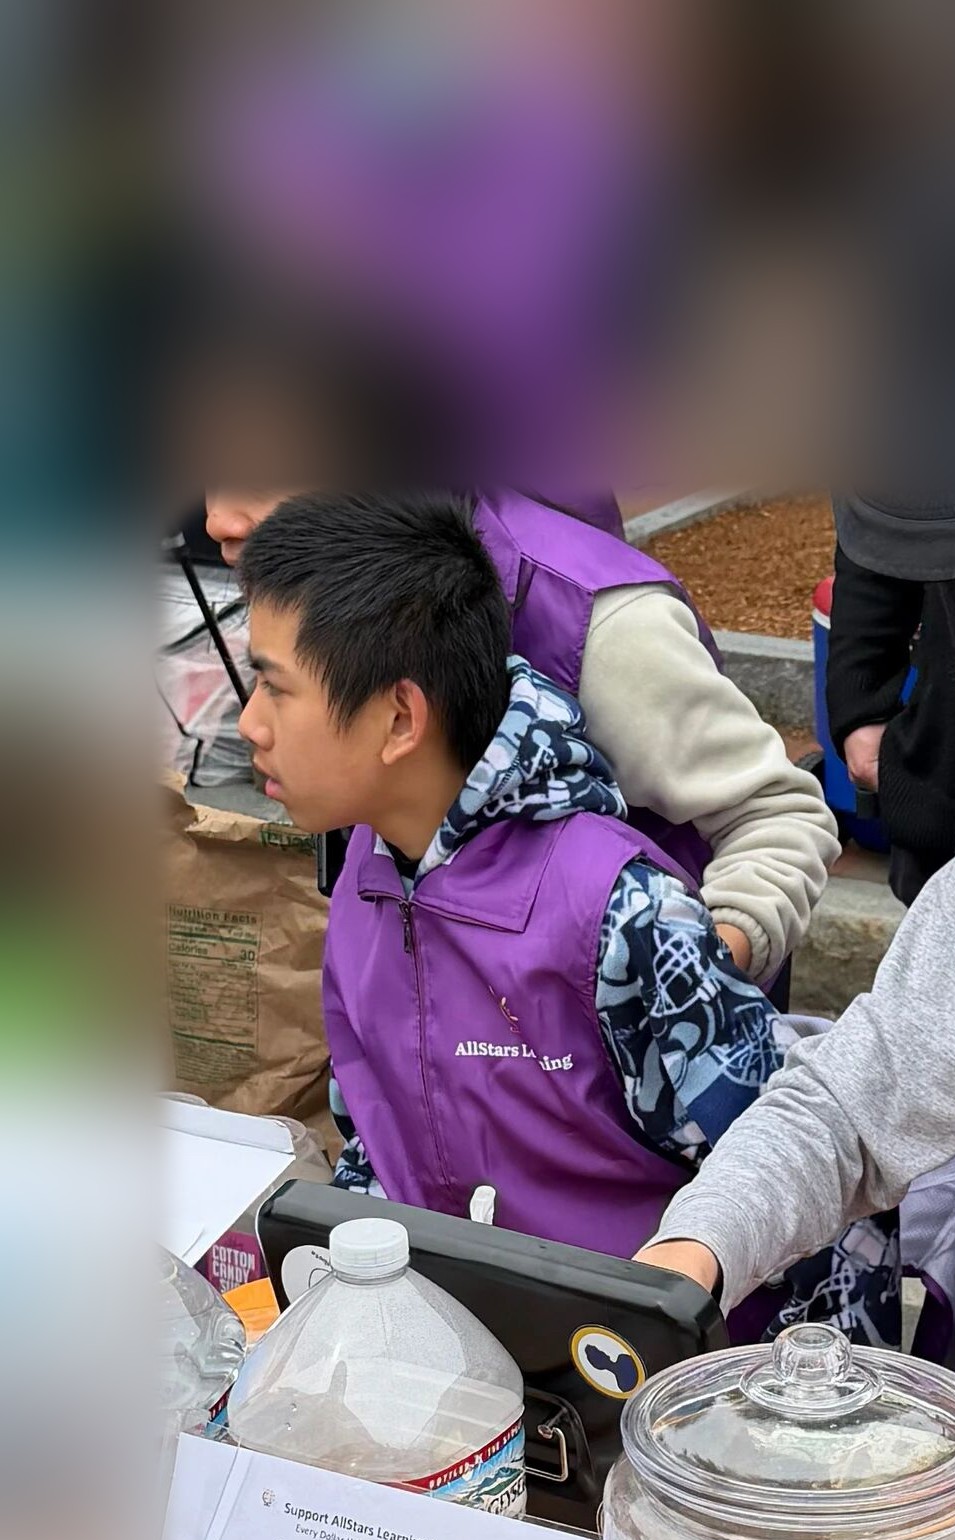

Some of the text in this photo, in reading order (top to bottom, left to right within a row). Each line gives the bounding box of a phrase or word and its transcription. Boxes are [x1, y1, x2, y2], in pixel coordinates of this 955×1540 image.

[455, 1041, 519, 1057] AllStars
[212, 1244, 255, 1272] COTTON
[212, 1260, 251, 1284] CANDY
[284, 1502, 329, 1525] Support
[331, 1514, 375, 1537] AllStars
[295, 1523, 319, 1540] Every
